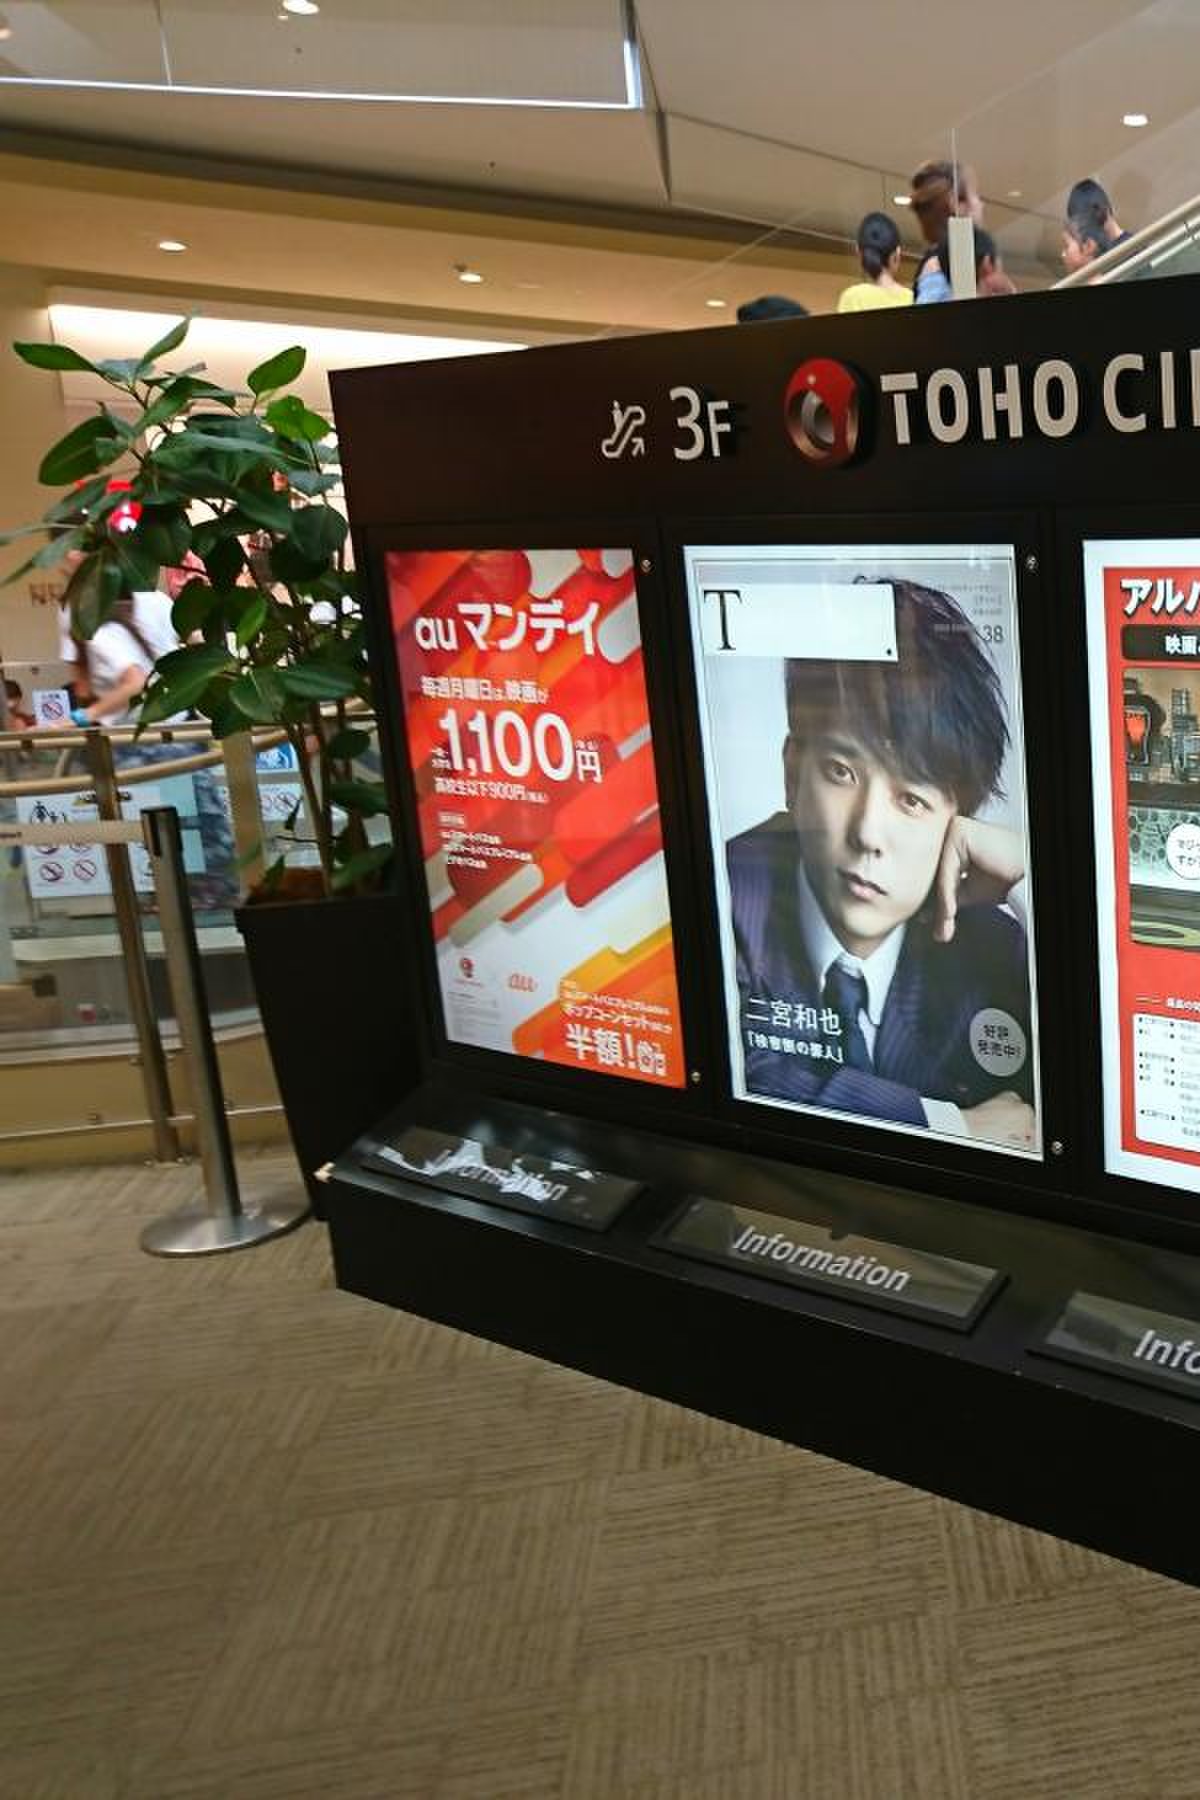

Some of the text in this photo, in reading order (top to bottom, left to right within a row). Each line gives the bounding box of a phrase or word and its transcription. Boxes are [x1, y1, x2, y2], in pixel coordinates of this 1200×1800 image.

[671, 387, 732, 460] 3F
[880, 360, 1079, 446] TOHO
[414, 601, 600, 656] auマンデイ
[746, 997, 842, 1036] 二宮和也
[732, 1224, 910, 1293] Information
